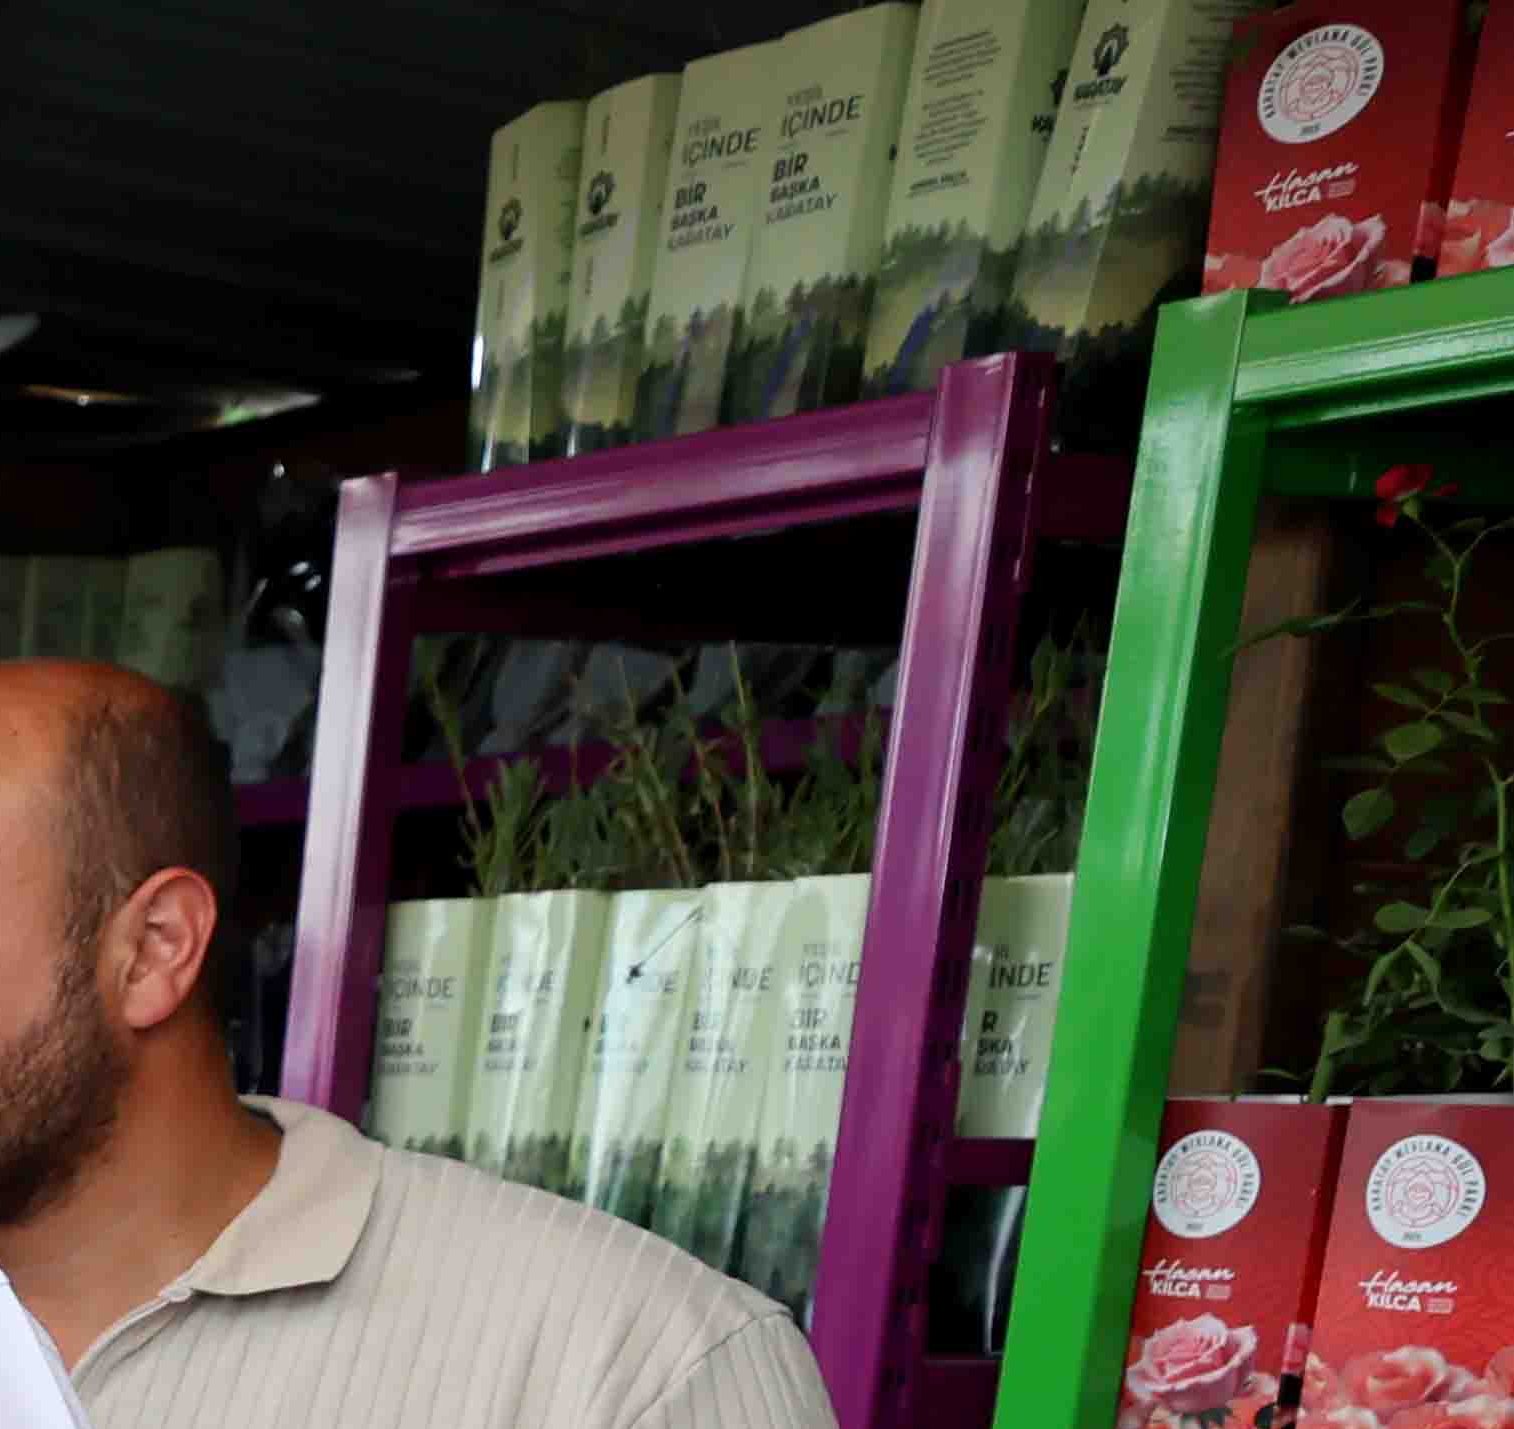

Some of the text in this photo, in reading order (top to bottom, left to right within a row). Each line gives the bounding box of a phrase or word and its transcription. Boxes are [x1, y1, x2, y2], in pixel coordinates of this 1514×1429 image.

[772, 150, 809, 182] BİR
[1142, 1258, 1237, 1283] Hasan
[1358, 1268, 1458, 1296] Hasan
[1150, 1279, 1202, 1298] KILCA
[1366, 1293, 1422, 1313] KILCA
